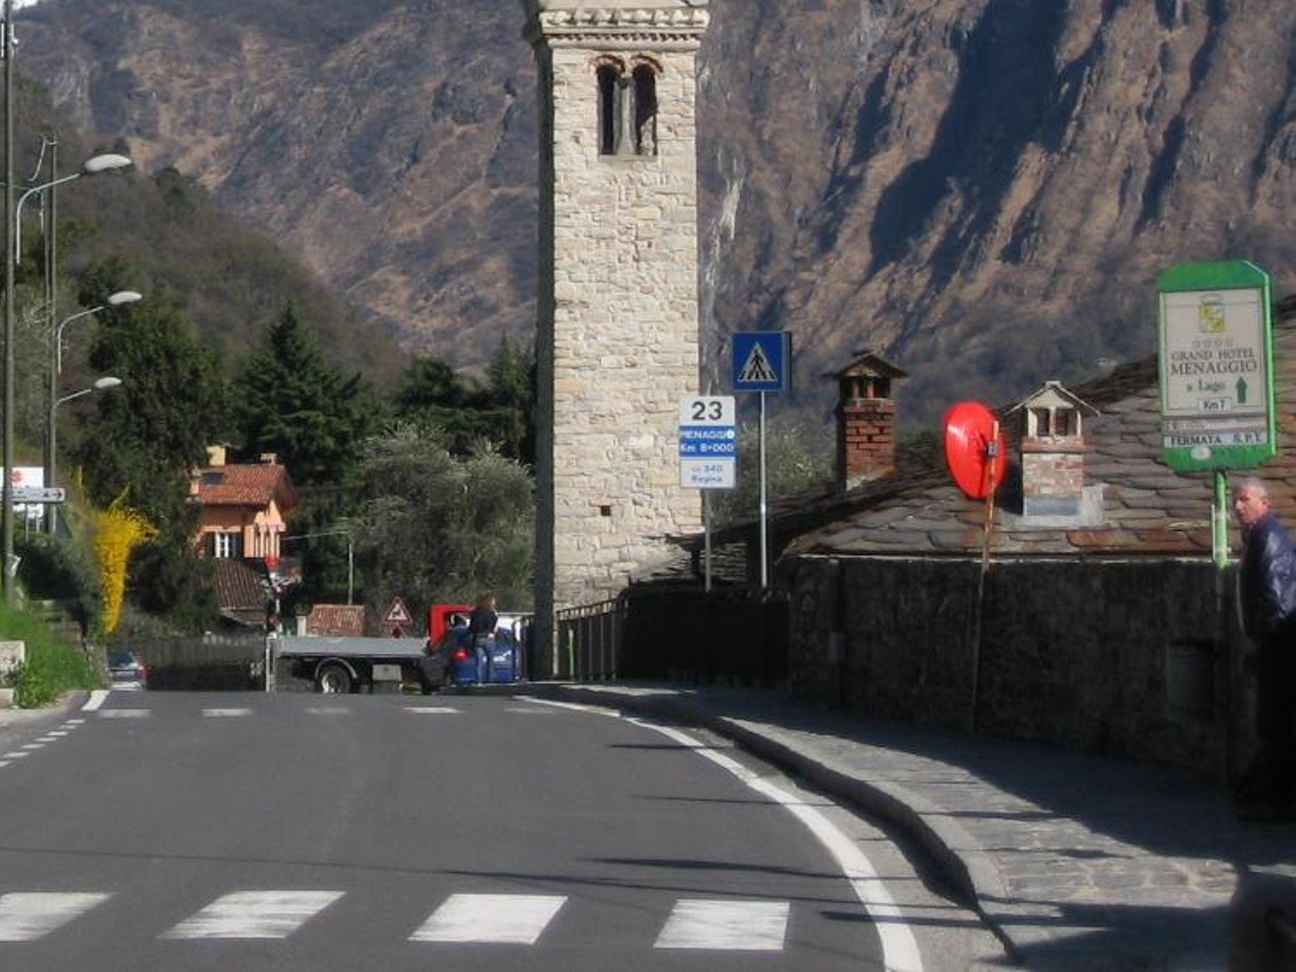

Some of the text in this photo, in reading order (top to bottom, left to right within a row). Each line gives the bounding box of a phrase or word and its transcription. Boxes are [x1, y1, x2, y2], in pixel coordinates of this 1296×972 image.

[1171, 348, 1254, 361] GRAND HOTEL
[1170, 358, 1257, 376] MENAGGIO
[691, 400, 723, 420] 23
[1171, 435, 1222, 446] FERMATA
